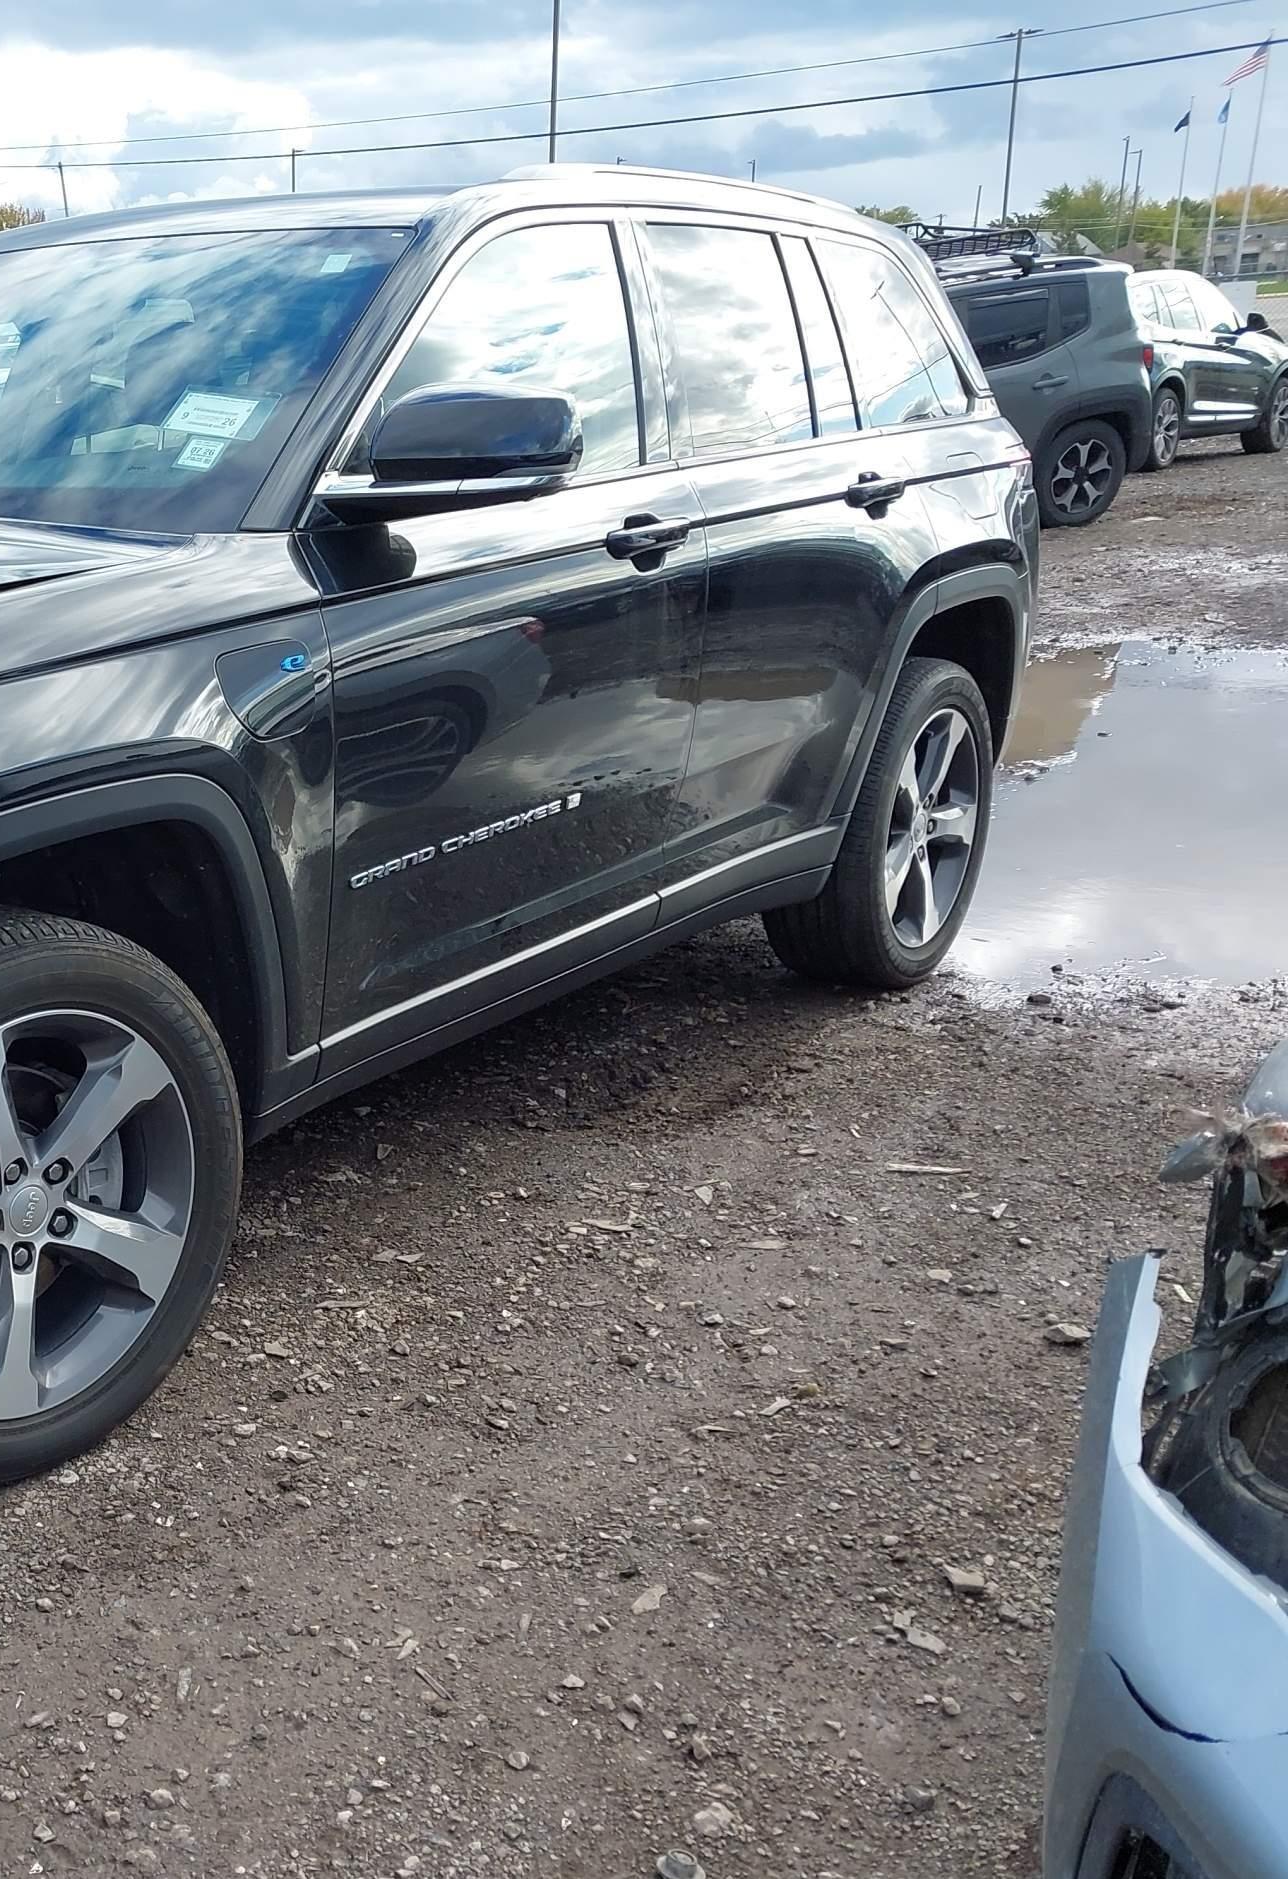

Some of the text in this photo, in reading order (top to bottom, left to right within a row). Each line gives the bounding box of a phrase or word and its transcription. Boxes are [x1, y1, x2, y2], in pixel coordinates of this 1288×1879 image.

[222, 417, 238, 427] 26
[349, 799, 563, 889] GRAND CHEROKEE
[22, 1191, 40, 1228] Jeep
